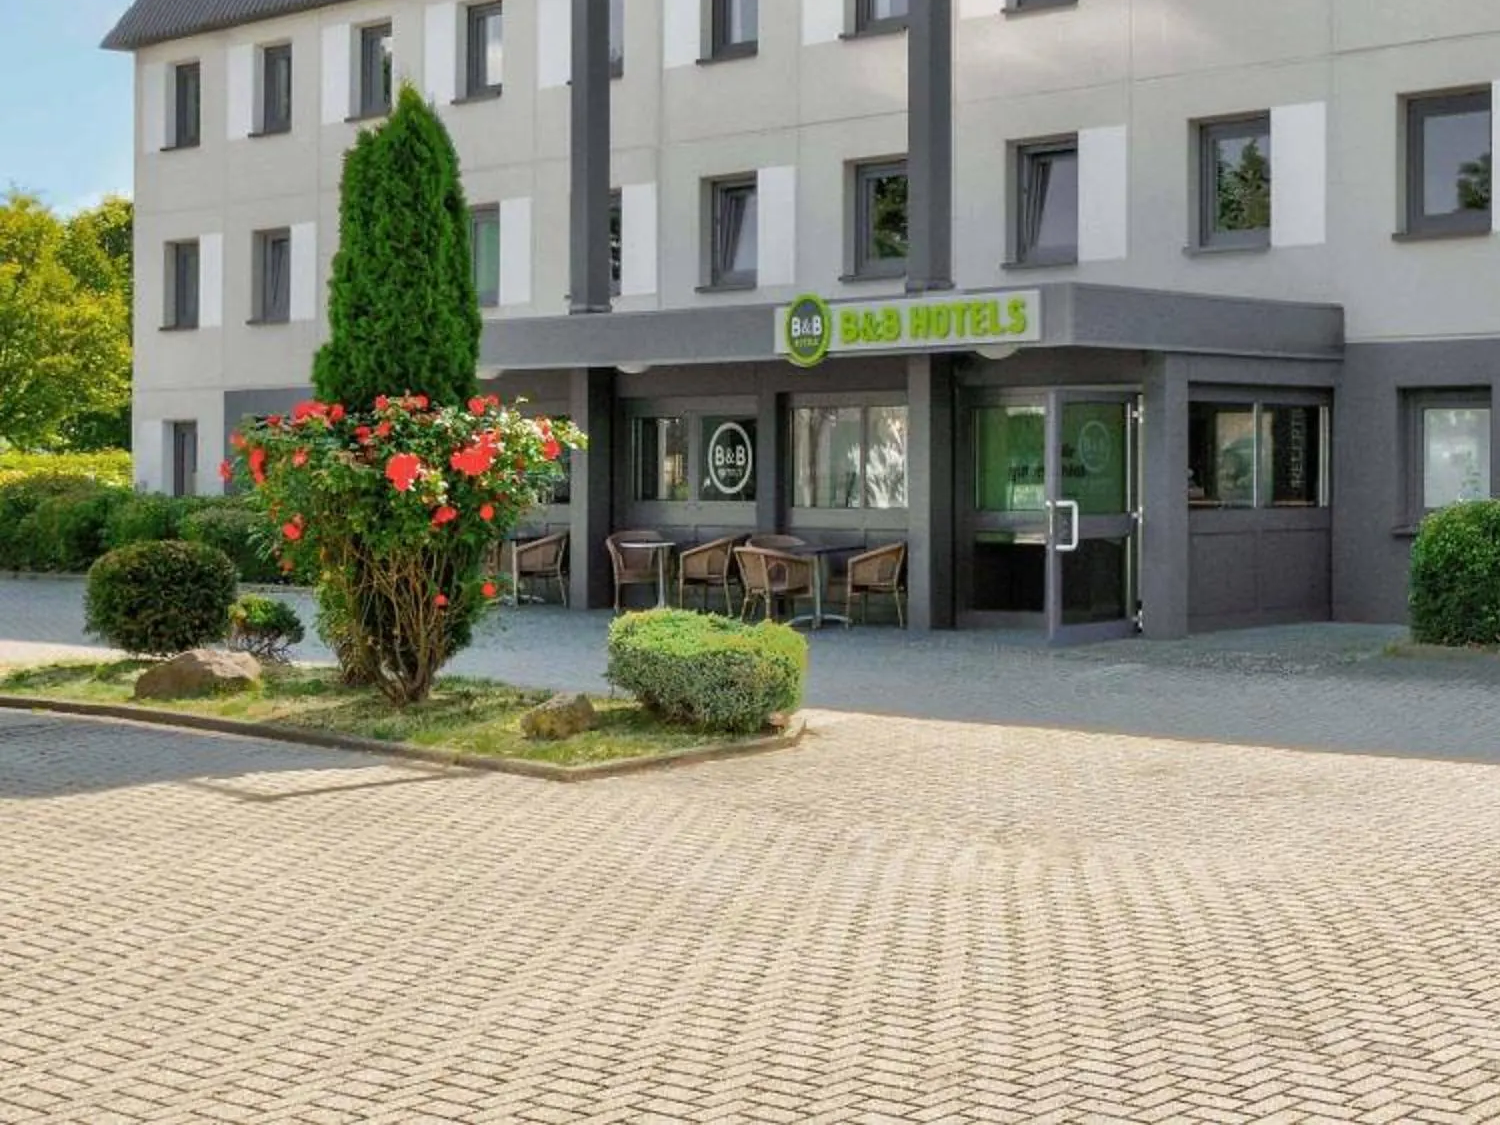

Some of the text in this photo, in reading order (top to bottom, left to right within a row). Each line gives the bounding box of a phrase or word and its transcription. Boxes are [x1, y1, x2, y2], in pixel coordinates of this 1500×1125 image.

[791, 315, 823, 338] B&B
[840, 297, 1027, 344] B&B HOTELS
[715, 444, 746, 466] B&B
